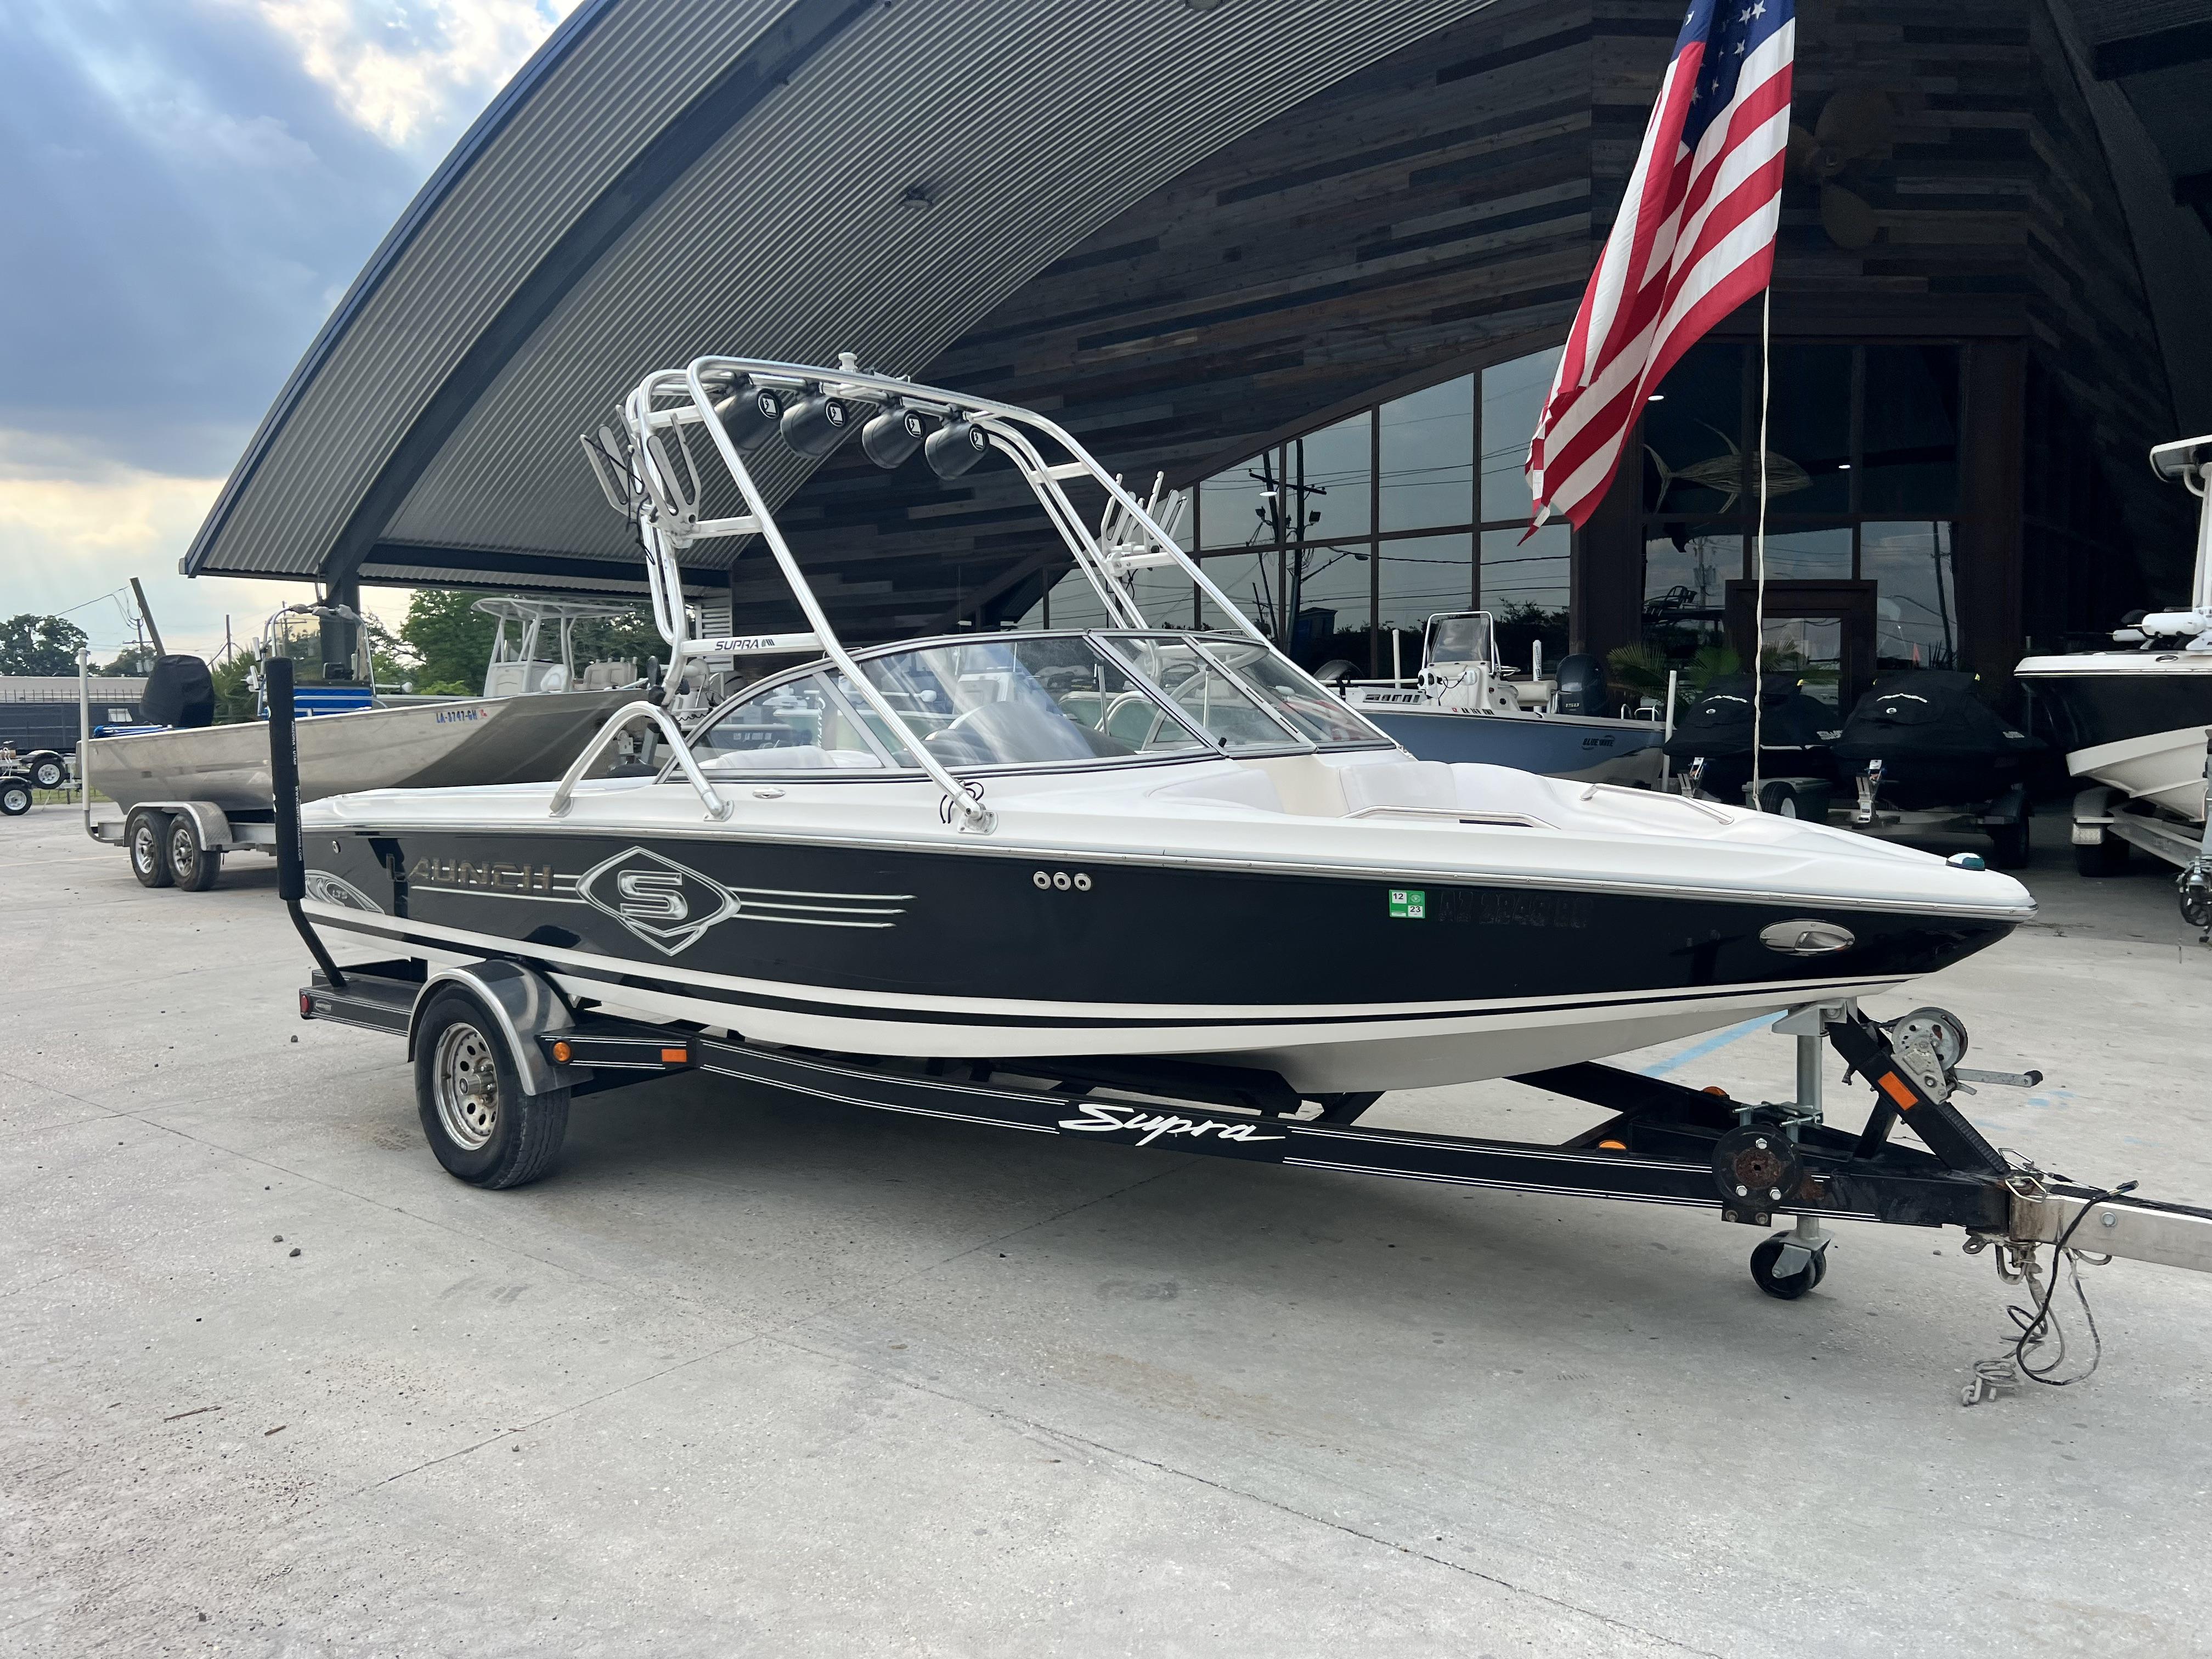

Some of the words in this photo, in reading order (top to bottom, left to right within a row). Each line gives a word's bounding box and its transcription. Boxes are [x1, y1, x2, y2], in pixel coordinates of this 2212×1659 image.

[715, 639, 759, 651] SUPRA
[386, 853, 553, 892] LAUNCH
[617, 870, 688, 920] S
[1058, 1103, 1286, 1147] Supra
